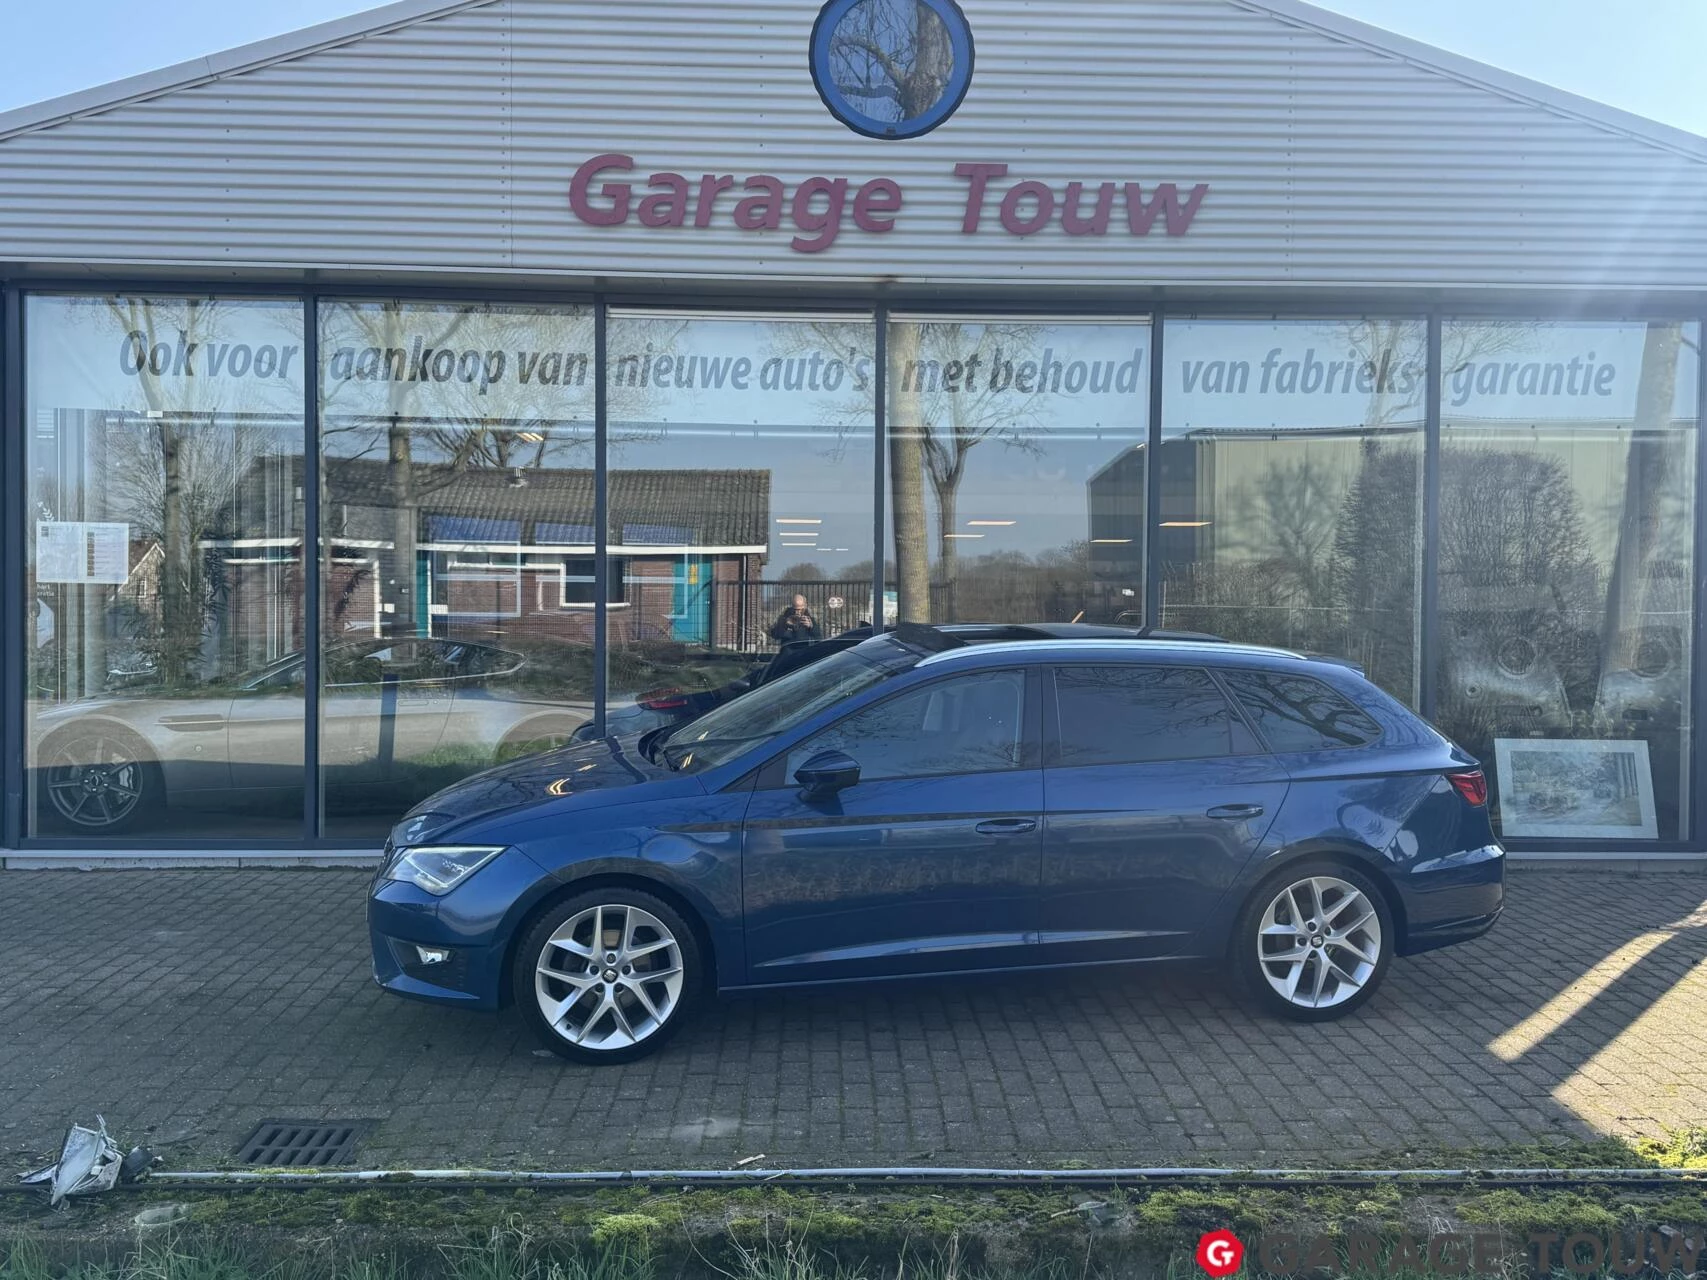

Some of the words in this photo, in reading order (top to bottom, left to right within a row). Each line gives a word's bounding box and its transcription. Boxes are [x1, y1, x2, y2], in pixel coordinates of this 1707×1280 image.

[569, 153, 902, 252] Garage
[953, 163, 1209, 236] Touw
[119, 329, 198, 377] Ook
[206, 343, 298, 379] voor
[330, 336, 506, 396] aankoop
[517, 350, 588, 386] van
[614, 342, 750, 391] nieuwe
[760, 347, 870, 392] auto's
[901, 351, 982, 393] met
[989, 348, 1143, 394] behoud
[1182, 357, 1249, 394] van
[1259, 348, 1415, 394] fabrieks
[1451, 351, 1616, 407] garantie
